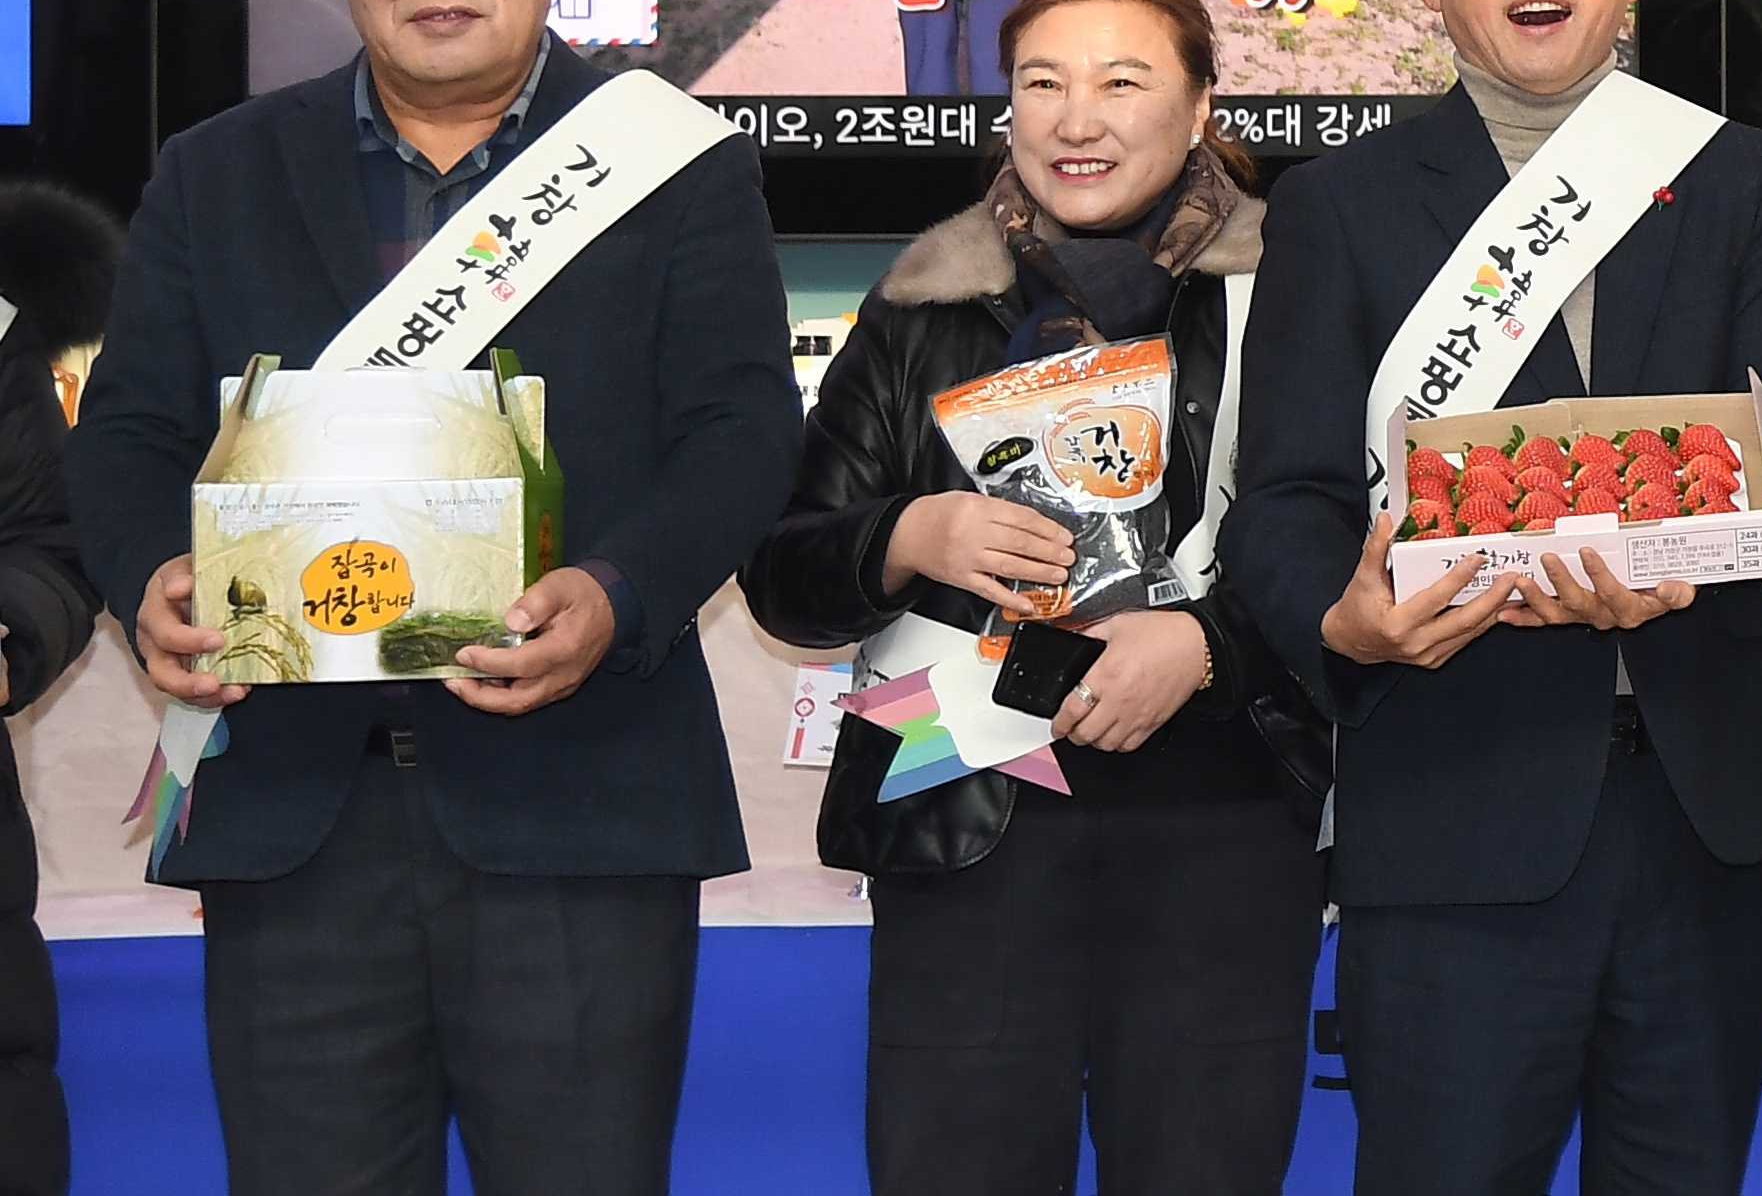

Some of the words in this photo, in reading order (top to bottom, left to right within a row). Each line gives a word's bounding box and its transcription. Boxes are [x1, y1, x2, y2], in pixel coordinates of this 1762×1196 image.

[834, 103, 977, 148] 2조원대
[1080, 419, 1135, 483] 거창
[330, 550, 397, 579] 잡곡이
